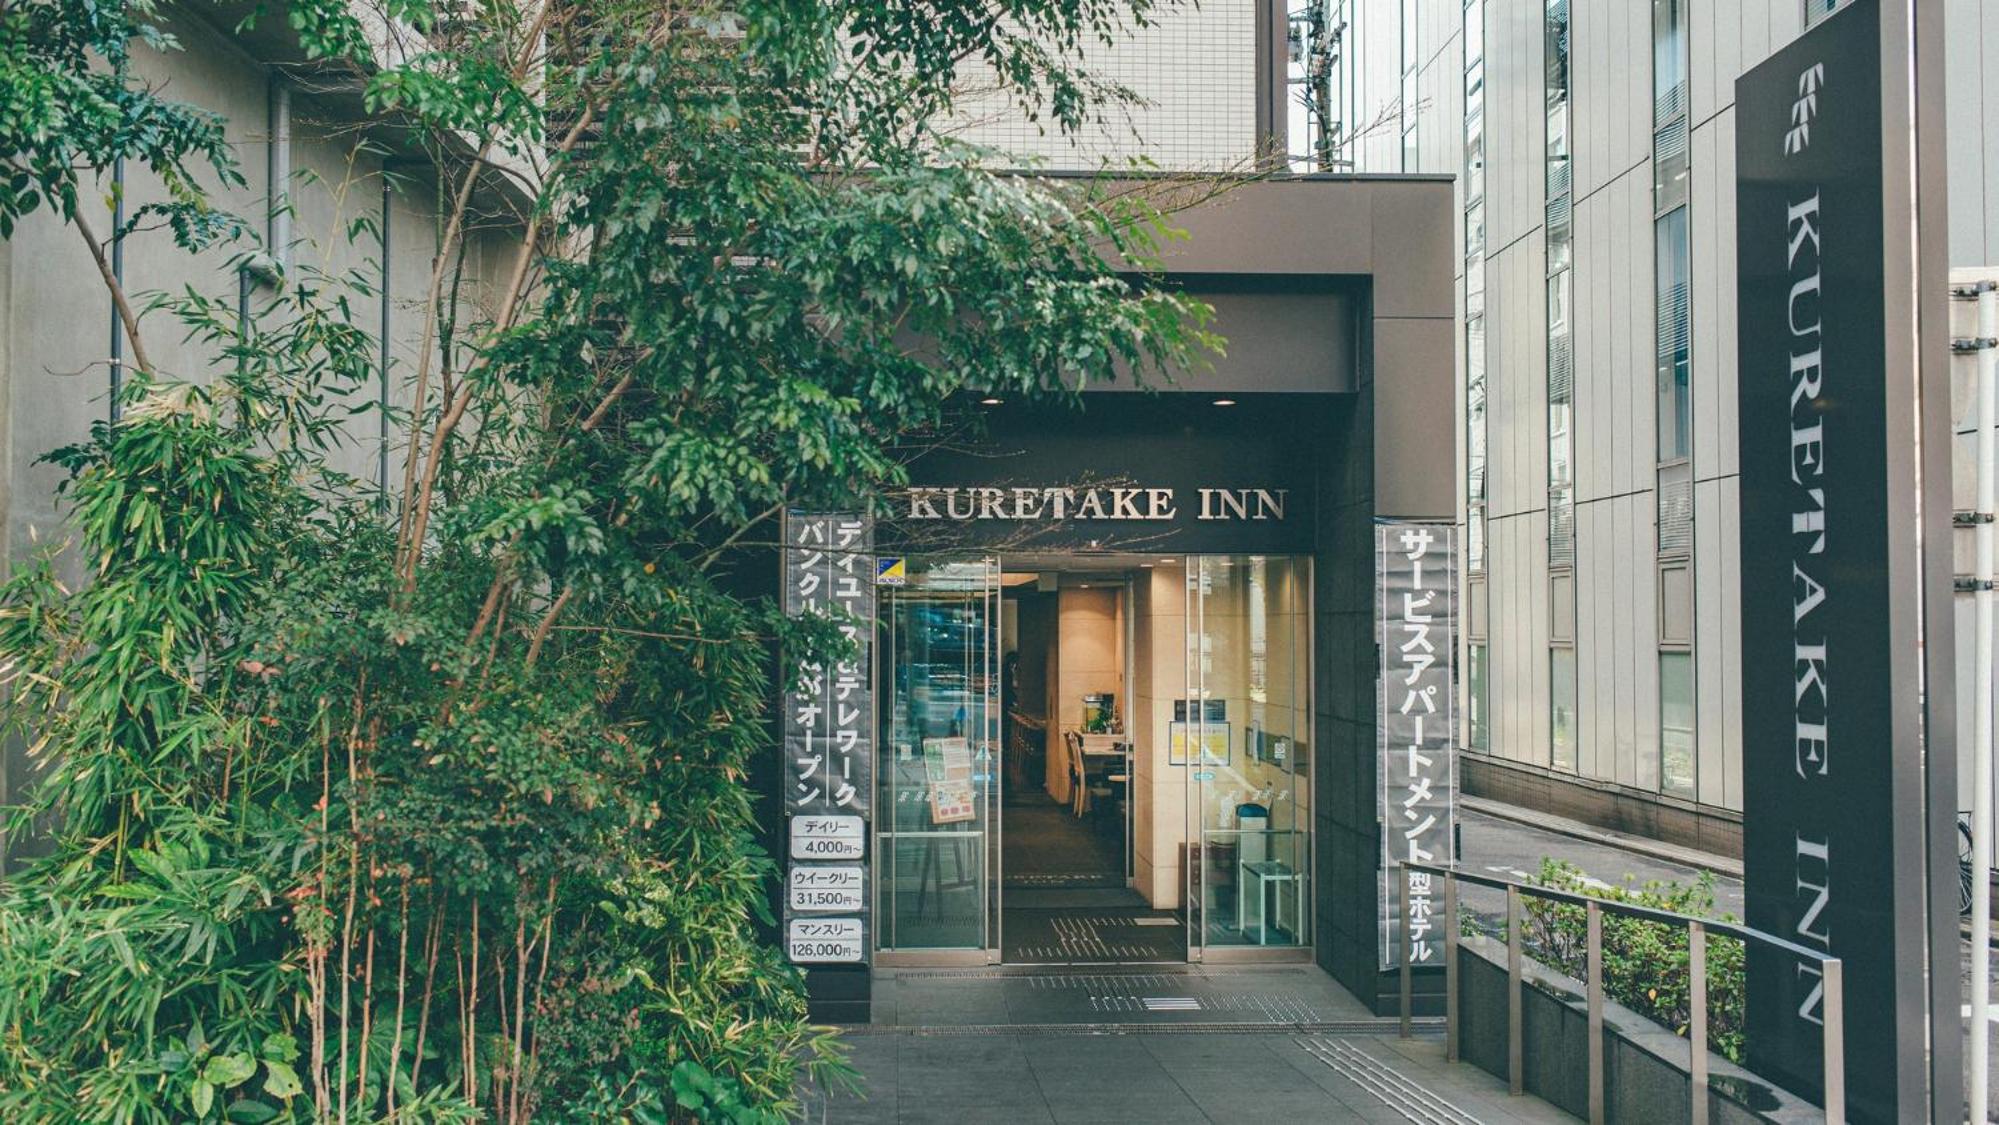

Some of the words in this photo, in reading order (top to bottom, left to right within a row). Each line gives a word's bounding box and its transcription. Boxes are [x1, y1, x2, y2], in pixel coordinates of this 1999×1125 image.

[907, 487, 1177, 520] KURETAKE
[1197, 488, 1289, 520] INN
[1788, 187, 1828, 780] KURETAKE
[1400, 529, 1437, 963] サービスアパートメント型ホテル
[805, 821, 850, 834] デイリー
[798, 923, 855, 936] マンスリー
[1797, 830, 1830, 1027] INN
